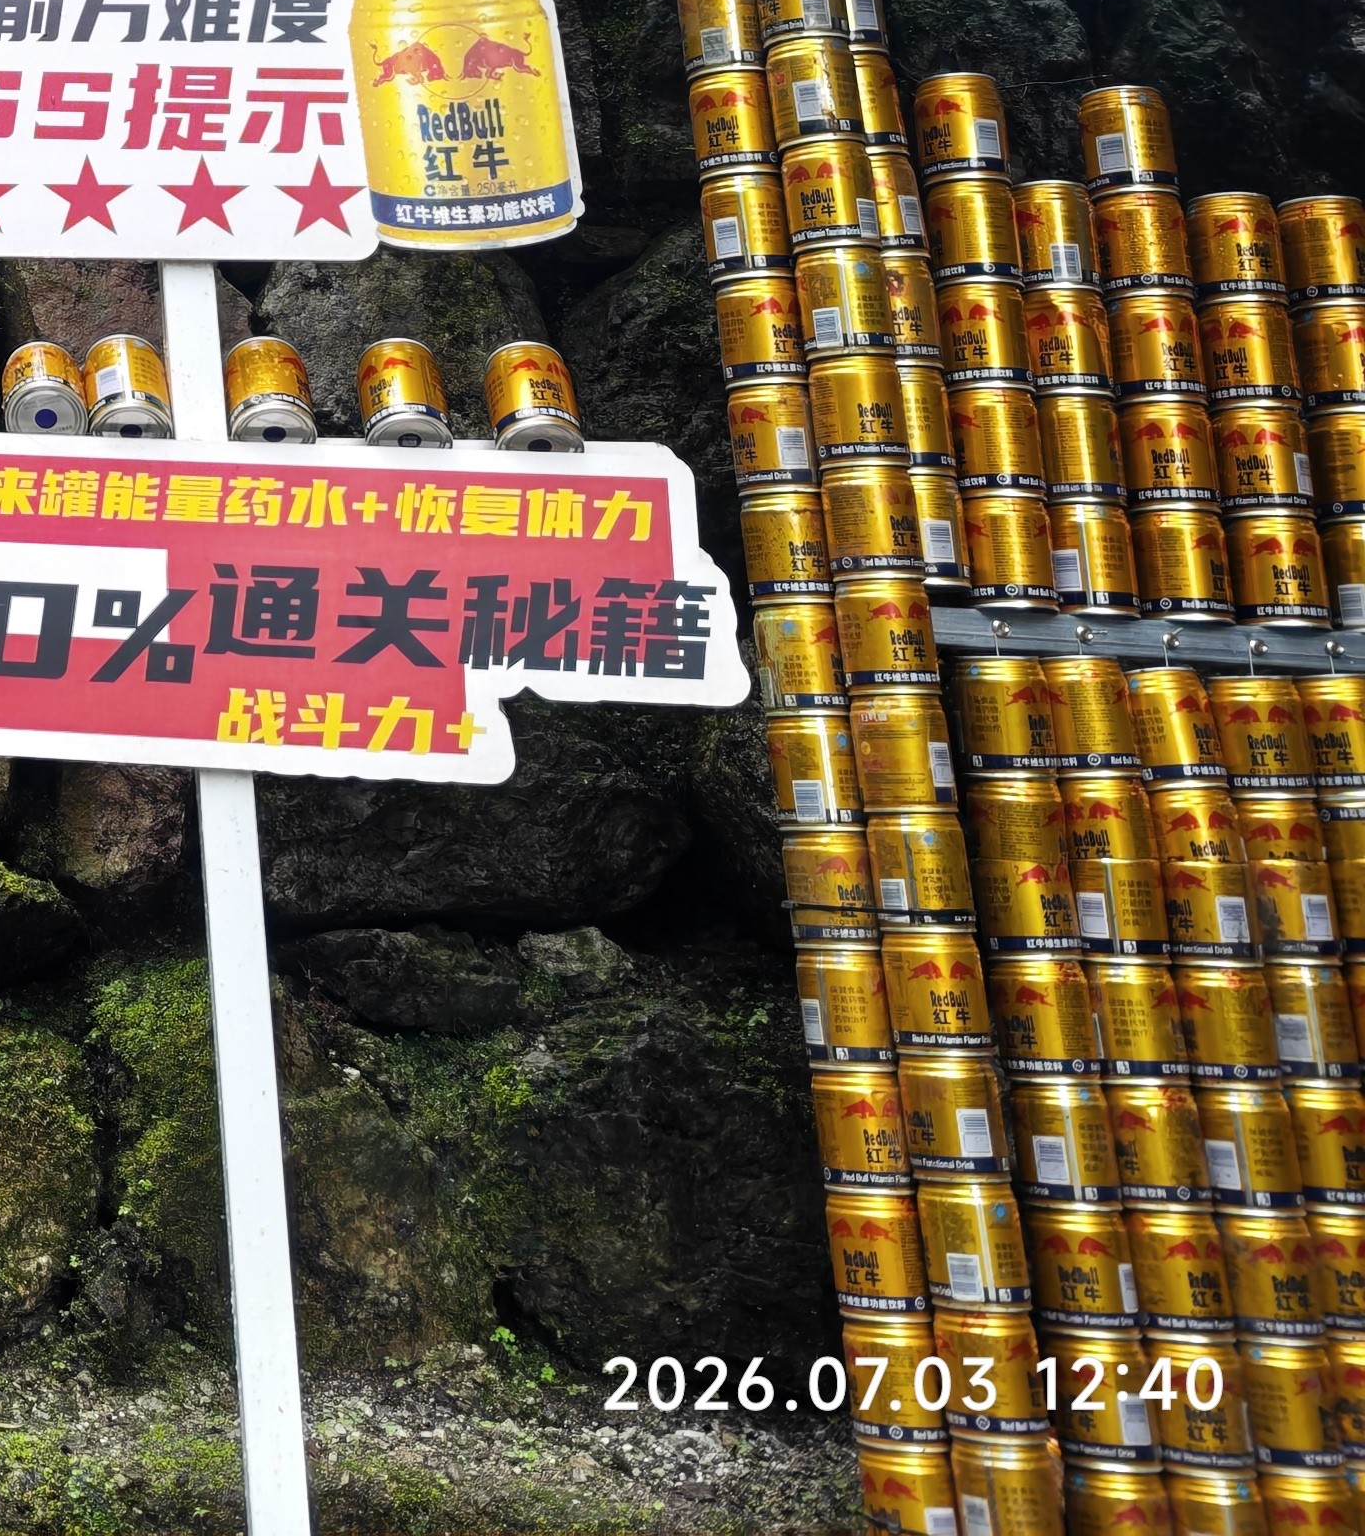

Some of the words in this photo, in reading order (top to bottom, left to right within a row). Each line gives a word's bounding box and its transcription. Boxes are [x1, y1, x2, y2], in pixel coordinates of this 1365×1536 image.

[417, 98, 504, 142] RedBull
[706, 115, 739, 134] RedBull
[707, 133, 742, 149] 红牛
[923, 140, 953, 156] 红牛
[423, 141, 509, 182] 红牛
[800, 187, 835, 206] RedBull
[395, 193, 555, 225] 红牛维生素功能饮料
[802, 203, 837, 221] 红牛
[1237, 258, 1272, 272] 红牛
[951, 330, 987, 346] RedBull
[1038, 336, 1074, 352] RedBull
[954, 345, 989, 362] 红牛
[1039, 350, 1075, 367] 红牛
[1163, 359, 1196, 372] 红牛
[1215, 365, 1249, 380] 红牛
[530, 389, 567, 406] 红牛
[857, 403, 893, 420] RedBull
[859, 418, 895, 435] 红牛
[1151, 448, 1191, 464] RedBull
[1235, 454, 1273, 470] RedBull
[1152, 465, 1193, 480] 红牛
[1237, 471, 1277, 486] 红牛
[1271, 564, 1310, 582] RedBull
[1274, 580, 1312, 596] 红牛
[889, 629, 925, 647] RedBull
[891, 646, 927, 662] 红牛
[216, 687, 487, 756] 战斗力+
[1247, 733, 1288, 751] RedBull
[1249, 751, 1290, 767] 红牛
[1316, 749, 1355, 766] 红牛
[929, 990, 969, 1009] RedBull
[932, 1008, 972, 1026] 红牛
[865, 1146, 903, 1164] 红牛
[845, 1267, 881, 1287] 红牛
[1061, 1283, 1102, 1303] 红牛
